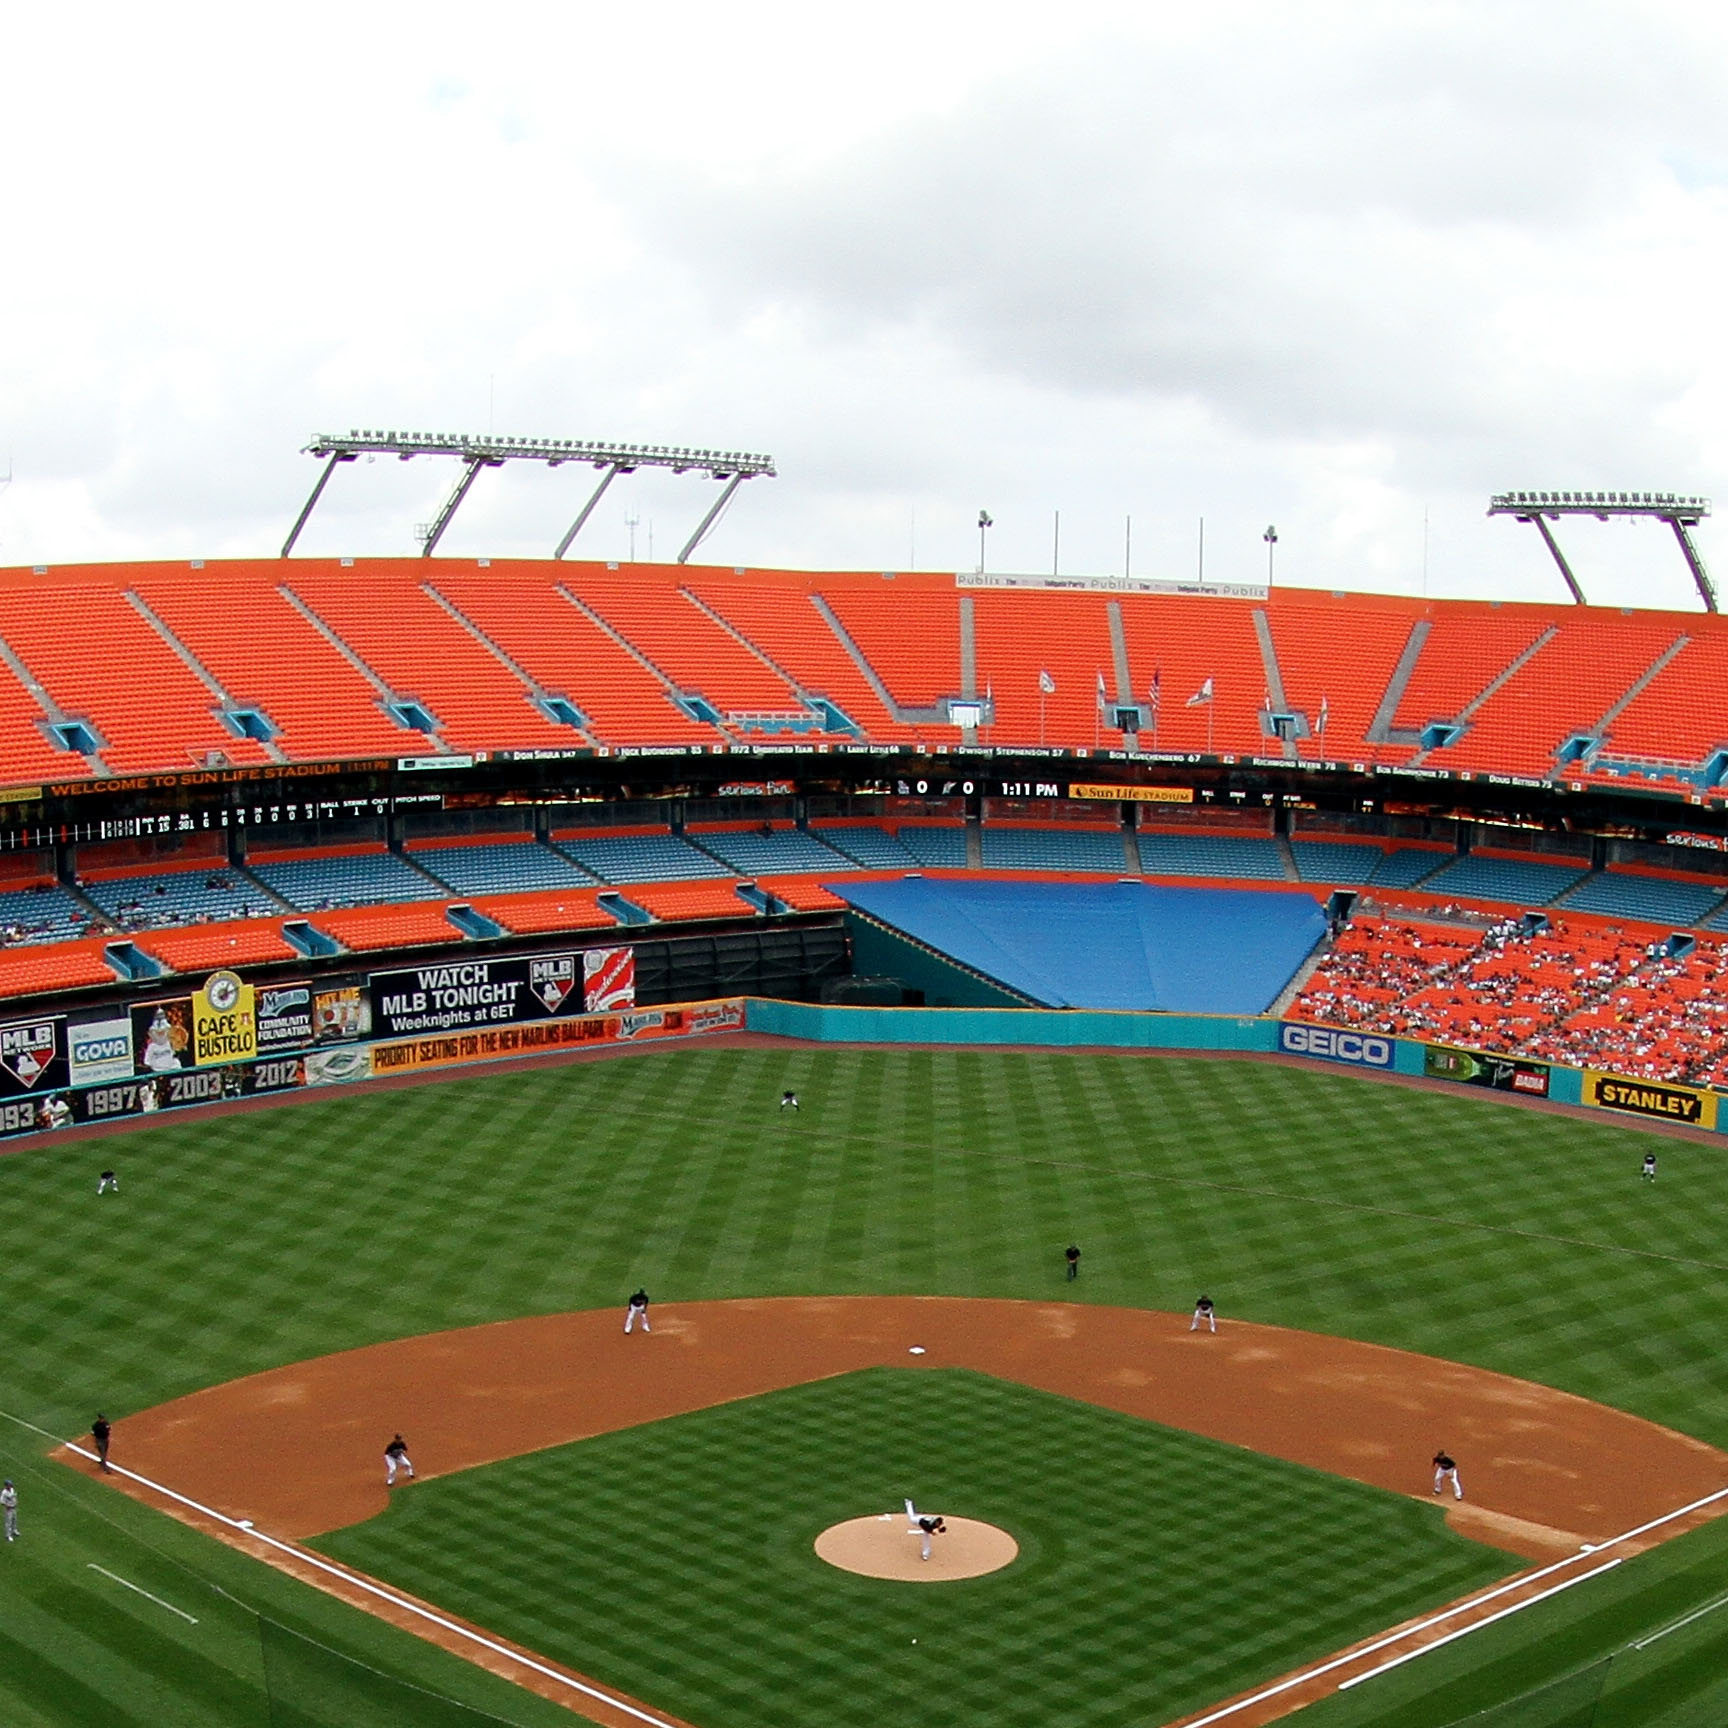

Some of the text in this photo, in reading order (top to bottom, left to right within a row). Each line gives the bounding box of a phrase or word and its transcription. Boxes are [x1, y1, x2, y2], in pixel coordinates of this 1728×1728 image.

[958, 575, 1000, 586] Publix
[1091, 580, 1131, 591] Publix
[1223, 586, 1265, 597] Publix
[513, 750, 532, 761] DON
[958, 746, 1050, 757] DWIGHT STEPHENSON
[1188, 754, 1201, 763] 67
[51, 776, 148, 797] WELCOME
[153, 774, 177, 787] TO
[180, 770, 218, 786] SUN
[222, 769, 255, 782] LIFE
[264, 763, 341, 779] STADIUM
[917, 781, 974, 795] 0 0
[1001, 782, 1058, 797] 1:11 PM
[1089, 786, 1113, 799] Sun
[1115, 787, 1141, 800] Life
[1143, 791, 1190, 801] STADIUM
[343, 799, 368, 808] STRIKE
[372, 798, 389, 806] OUT
[395, 794, 441, 804] PITCH SPEED
[1665, 834, 1718, 851] serious
[418, 964, 489, 990] WATCH
[533, 959, 571, 977] MLB
[382, 981, 517, 1016] MLB TONIGHT
[391, 1003, 516, 1032] Weeknights at 6ET
[2, 1026, 53, 1049] MLB
[198, 1032, 253, 1059] BUSTELO
[1283, 1025, 1390, 1065] GEICO
[75, 1039, 127, 1061] GOYA
[374, 1043, 417, 1068] PRIORITY
[419, 1040, 458, 1062] SEATING
[459, 1035, 479, 1056] FOR
[480, 1032, 497, 1053] THE
[499, 1029, 520, 1050] NEW
[255, 1060, 297, 1088] 2012
[1515, 1073, 1545, 1090] BADIA
[170, 1073, 221, 1101] 2003
[86, 1085, 137, 1116] 1997
[1601, 1083, 1696, 1117] STANLEY
